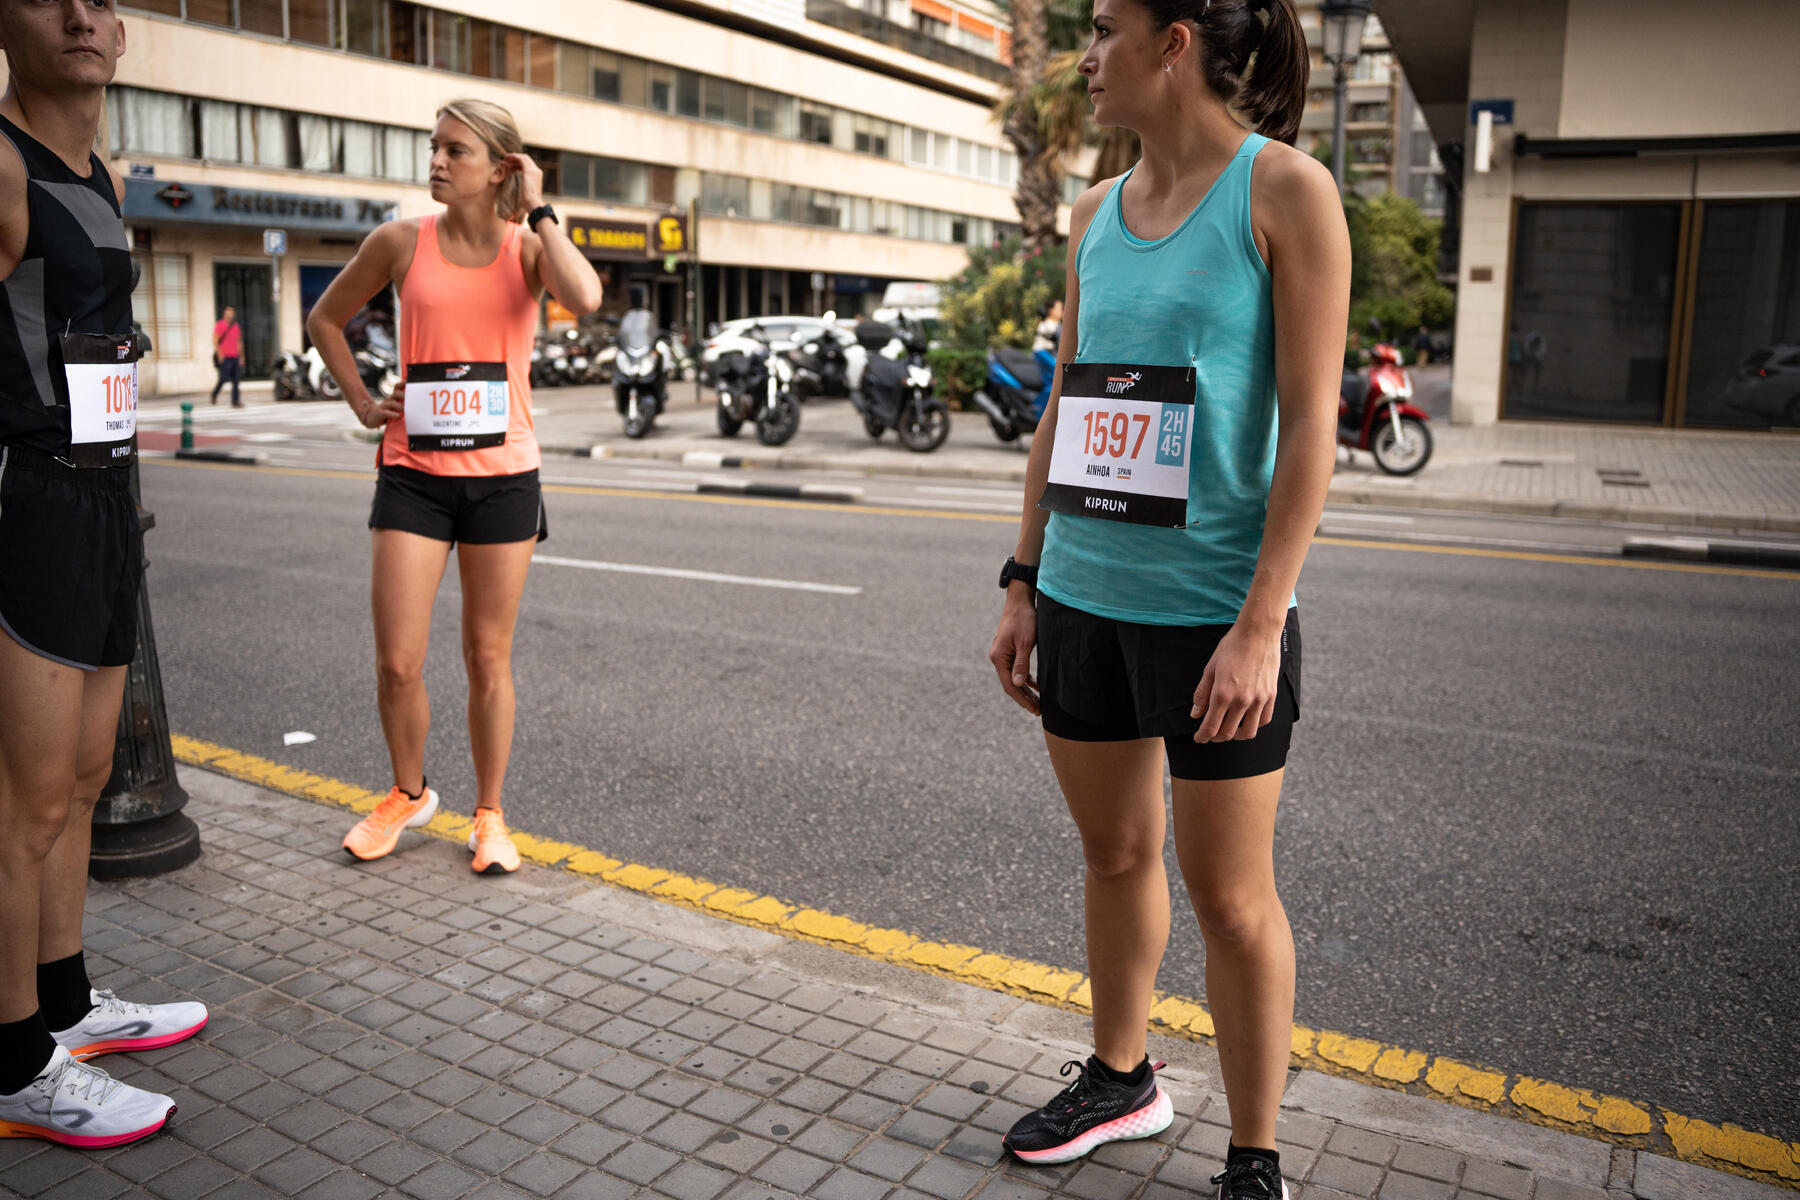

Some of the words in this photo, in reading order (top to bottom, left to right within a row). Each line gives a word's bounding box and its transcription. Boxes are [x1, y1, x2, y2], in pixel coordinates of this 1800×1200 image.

[429, 389, 482, 415] 1204
[489, 399, 503, 412] 30
[1162, 410, 1185, 433] 2H
[441, 438, 474, 447] KIPRUN
[1083, 410, 1151, 460] 1597
[1160, 435, 1182, 457] 45
[1086, 464, 1110, 478] AINHOA
[1117, 467, 1132, 476] SPAIN
[1085, 496, 1128, 513] KIPRUN
